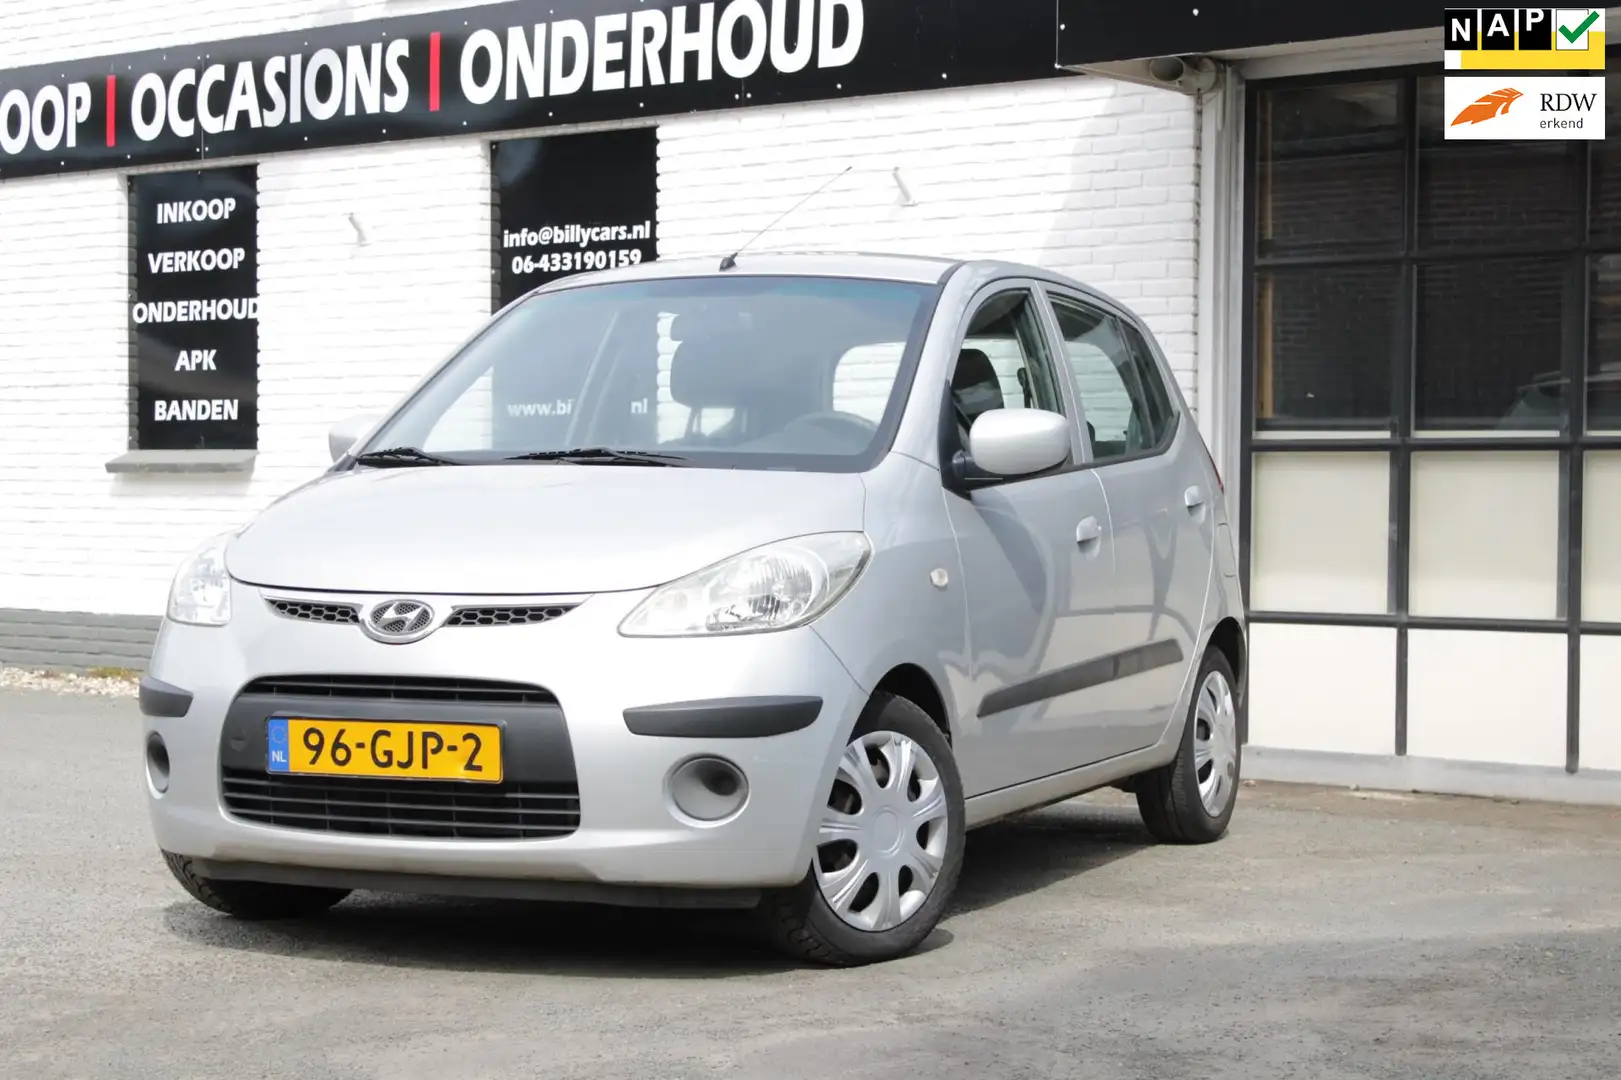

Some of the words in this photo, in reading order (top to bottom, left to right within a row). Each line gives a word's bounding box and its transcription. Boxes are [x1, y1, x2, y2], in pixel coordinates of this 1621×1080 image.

[131, 39, 410, 141] OCCASIONS
[460, 0, 864, 105] ONDERHOUD
[156, 198, 236, 224] INKOOP
[503, 220, 651, 248] info@billycars.nl
[148, 247, 246, 274] VERKOOP
[511, 249, 642, 274] 06-433190159
[132, 297, 258, 324] ONDERHOUD
[174, 349, 217, 372] APK
[154, 399, 239, 421] BANDEN
[271, 751, 287, 763] NL
[303, 727, 483, 772] 96-GJP-2
